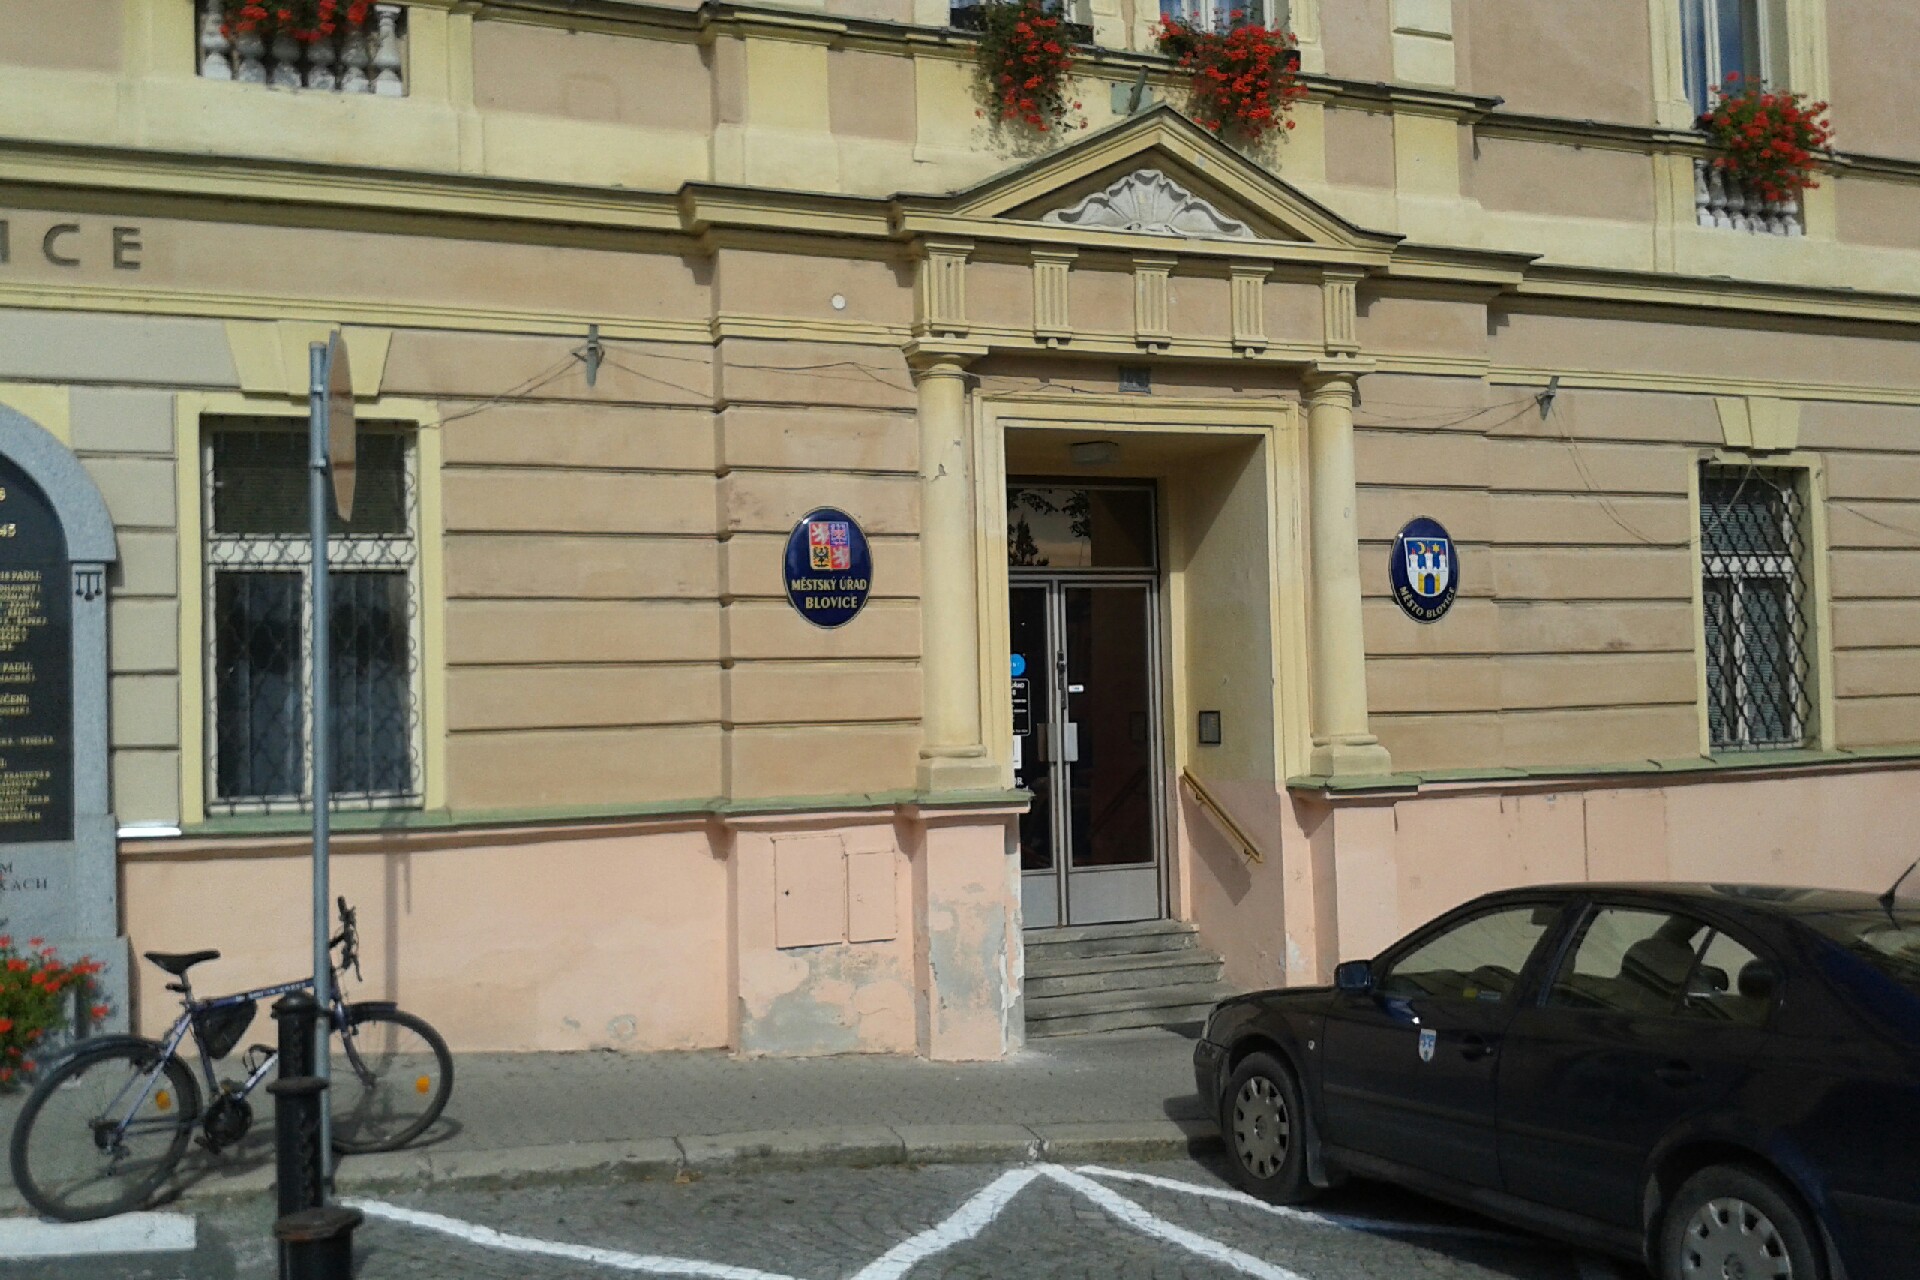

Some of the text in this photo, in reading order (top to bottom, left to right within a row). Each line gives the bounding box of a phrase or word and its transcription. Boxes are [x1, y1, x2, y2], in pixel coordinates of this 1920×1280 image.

[791, 575, 867, 591] MĚSTSKÝ ÚŘAD
[805, 595, 858, 609] BLOVICE
[1400, 586, 1424, 616] MĚSTO
